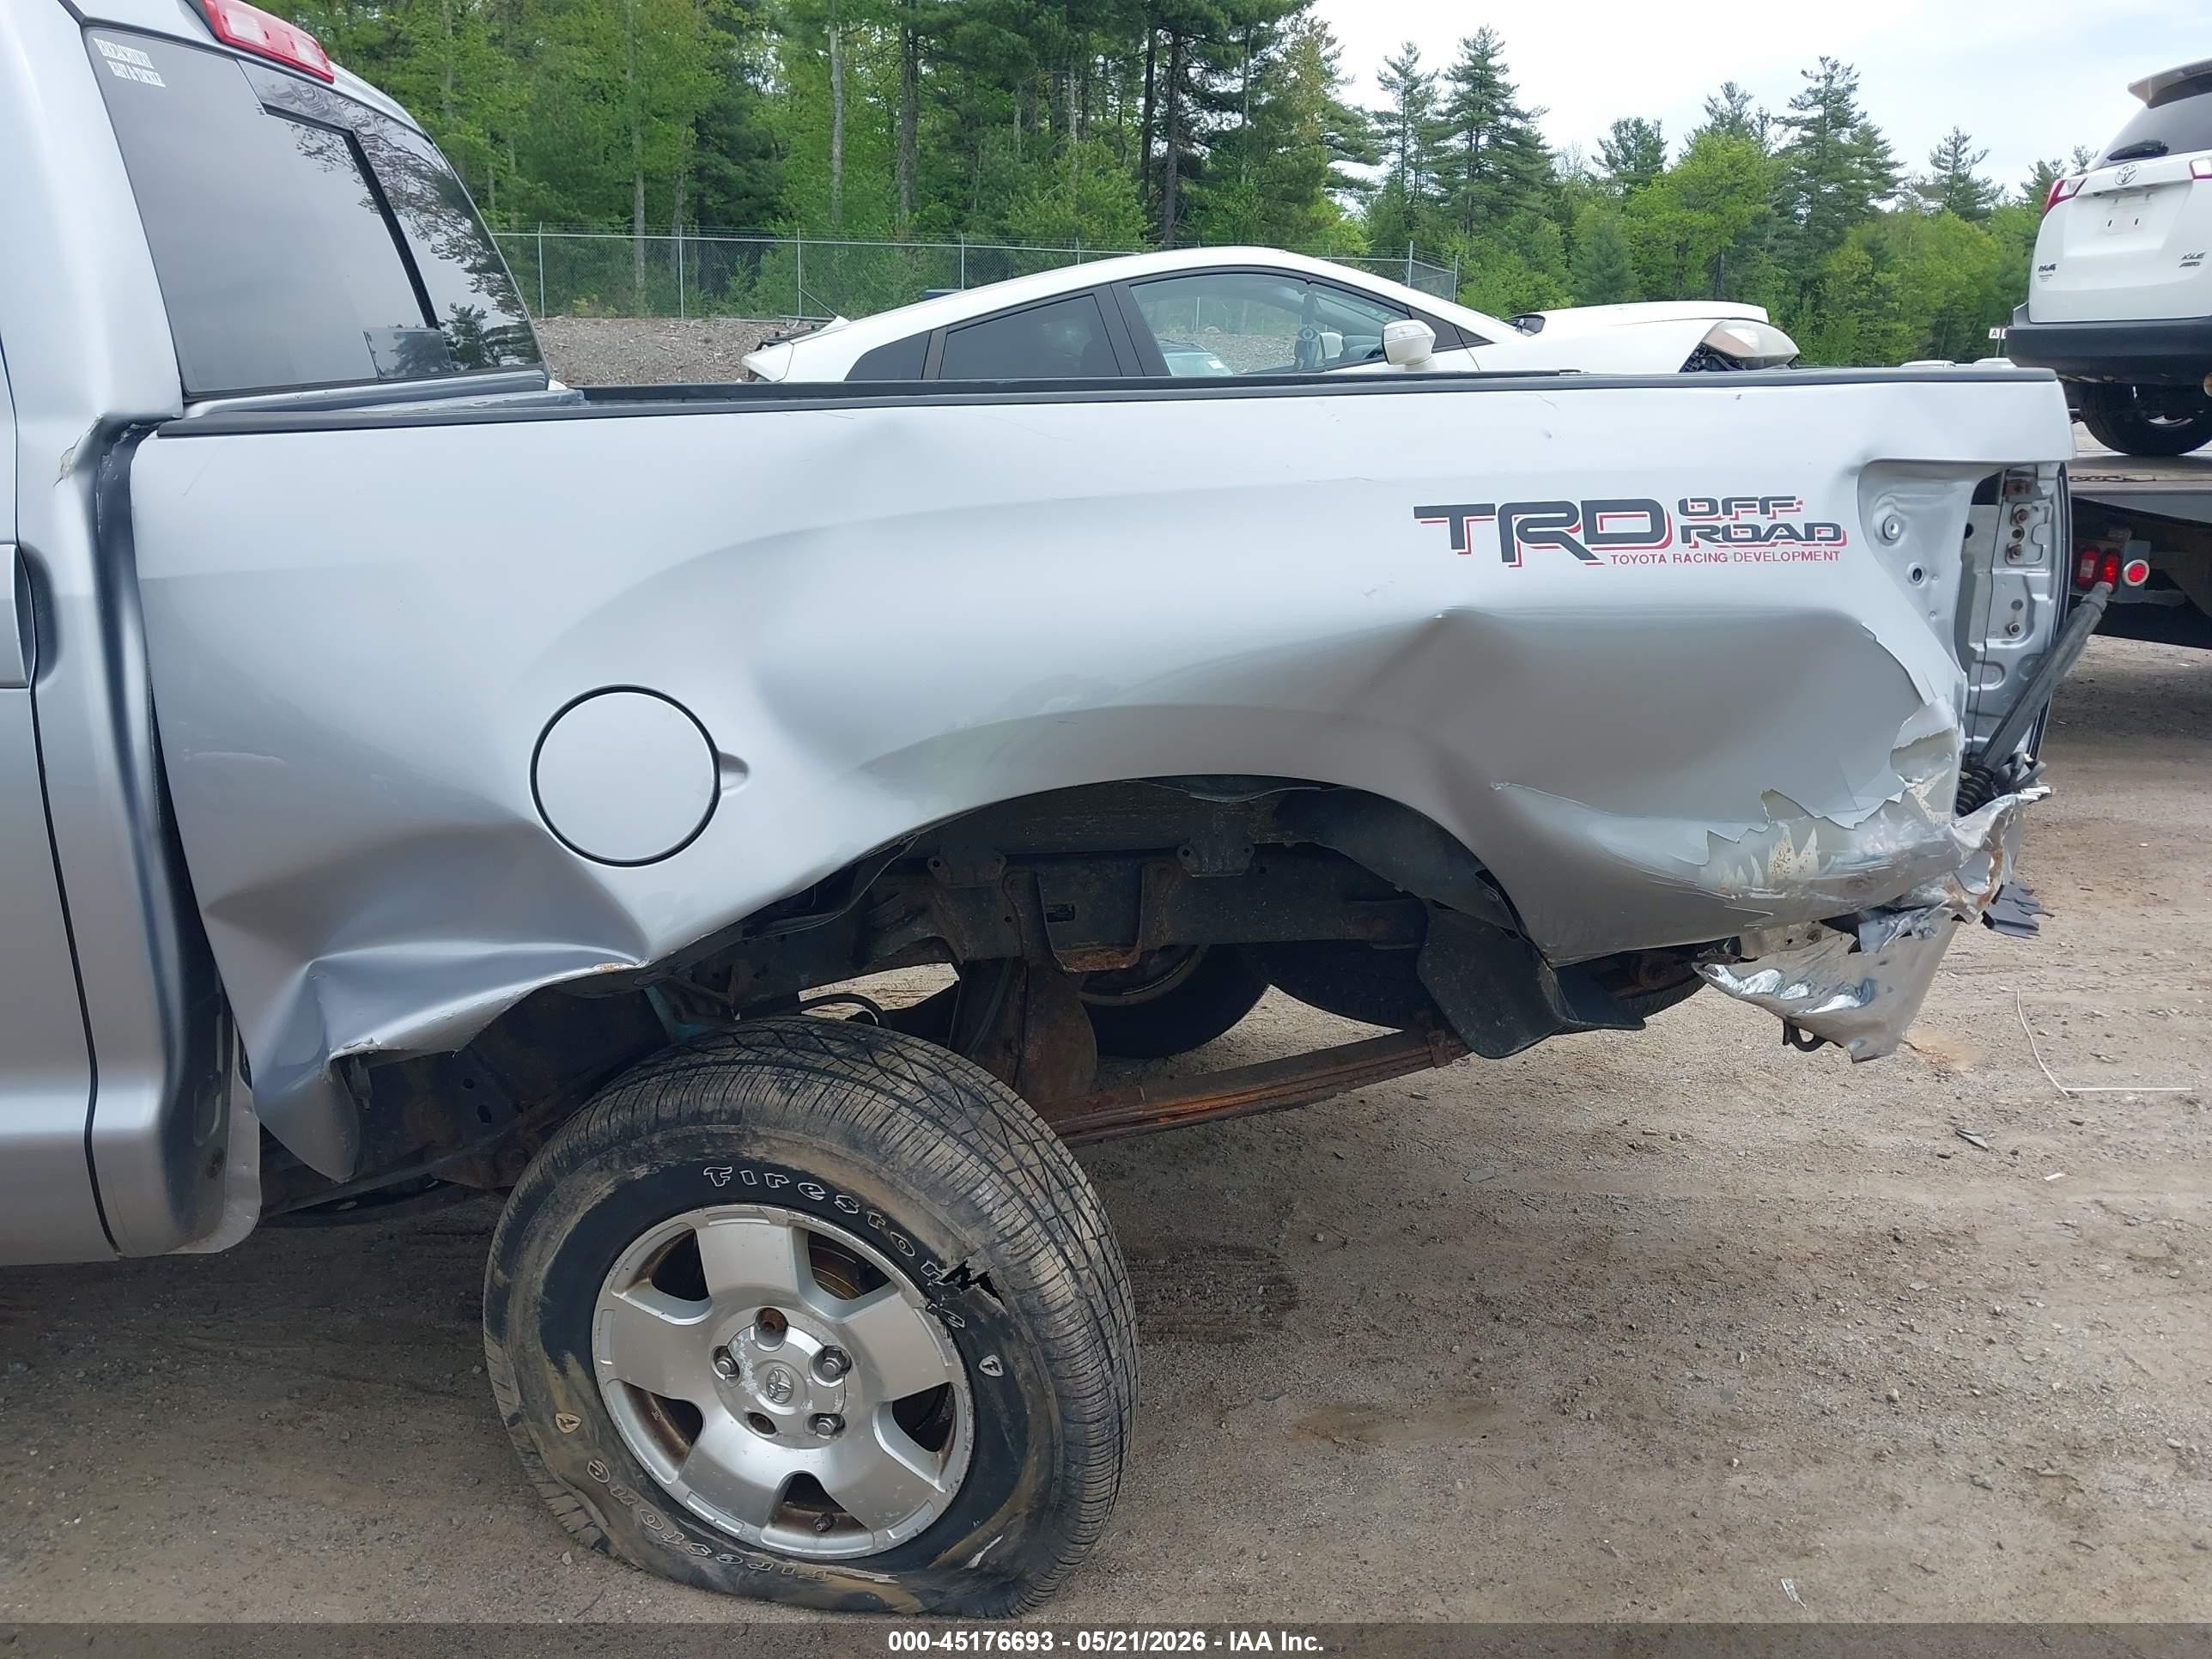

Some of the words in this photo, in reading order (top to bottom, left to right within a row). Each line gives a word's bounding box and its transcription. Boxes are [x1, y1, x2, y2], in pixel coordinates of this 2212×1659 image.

[1677, 495, 1803, 520] OFF
[1413, 498, 1673, 568] TRD
[1680, 521, 1848, 550] ROAD
[1610, 553, 1668, 566] TOYOTA
[1673, 551, 1728, 564] RACING
[1734, 550, 1841, 563] DEVELOPMENT
